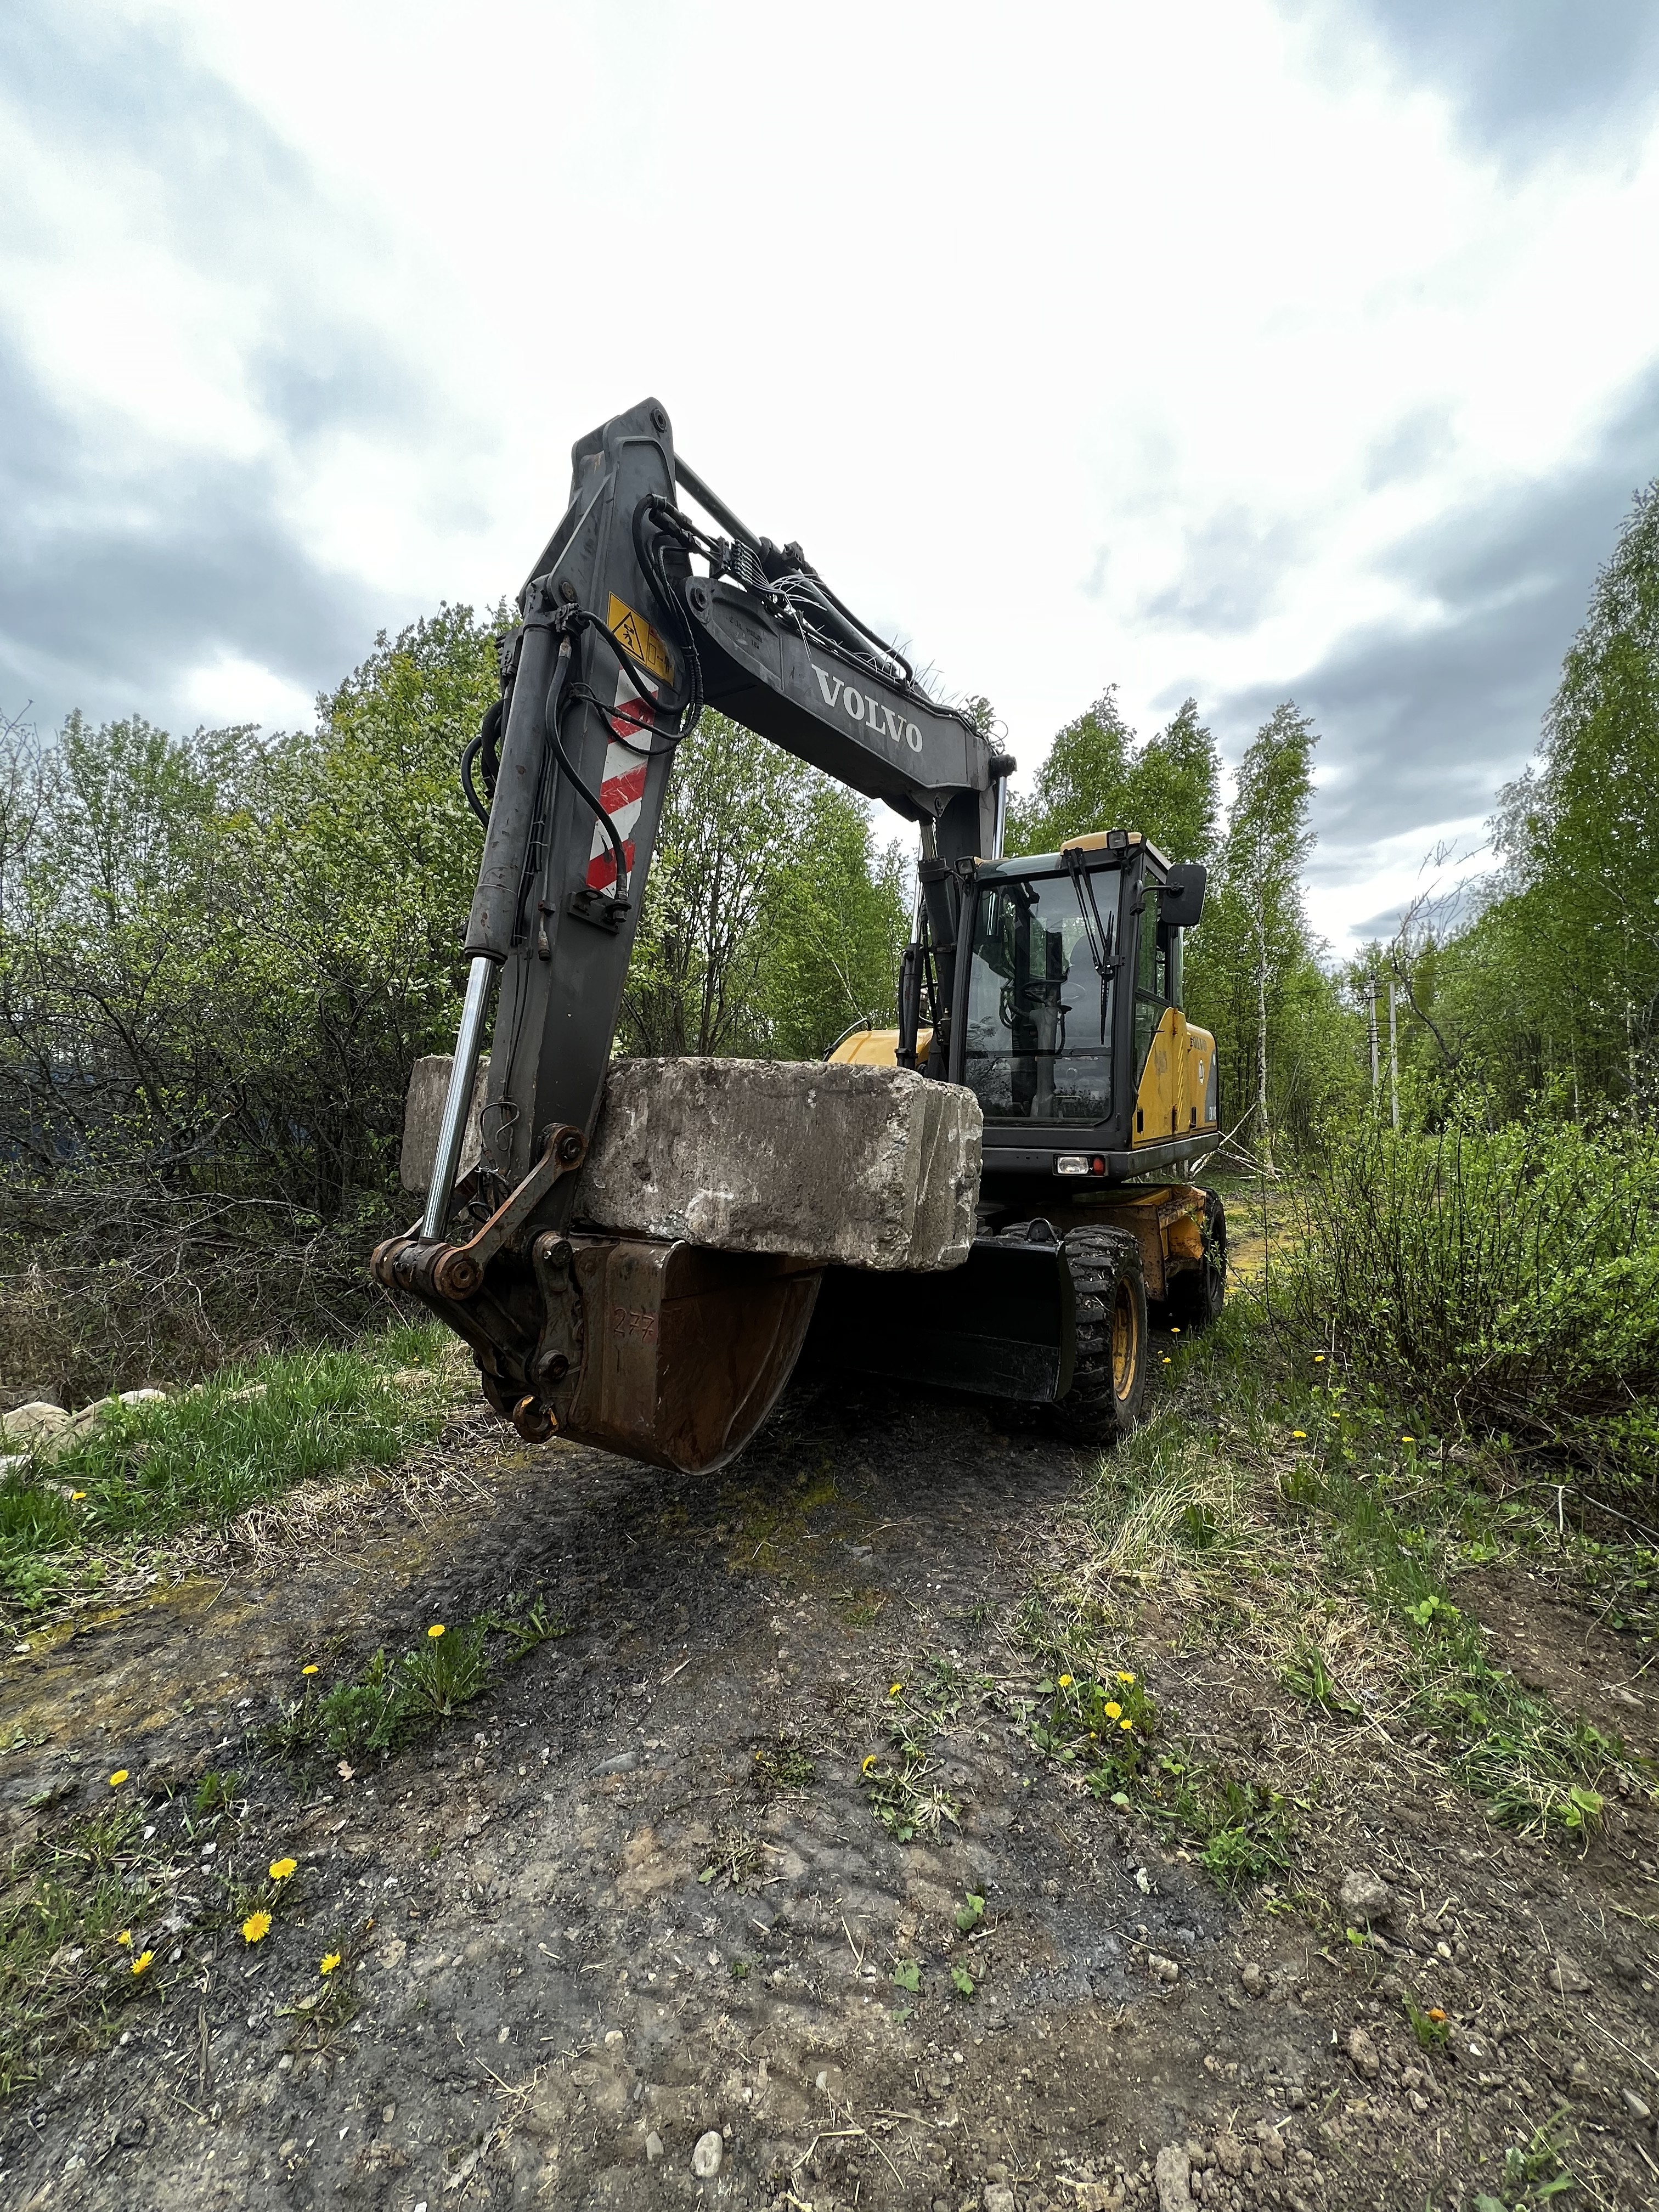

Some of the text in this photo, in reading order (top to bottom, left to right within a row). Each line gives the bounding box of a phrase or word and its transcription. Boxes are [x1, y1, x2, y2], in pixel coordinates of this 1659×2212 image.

[811, 663, 923, 753] VOLVO
[1193, 1036, 1207, 1052] OLVO
[614, 1307, 654, 1342] 277
